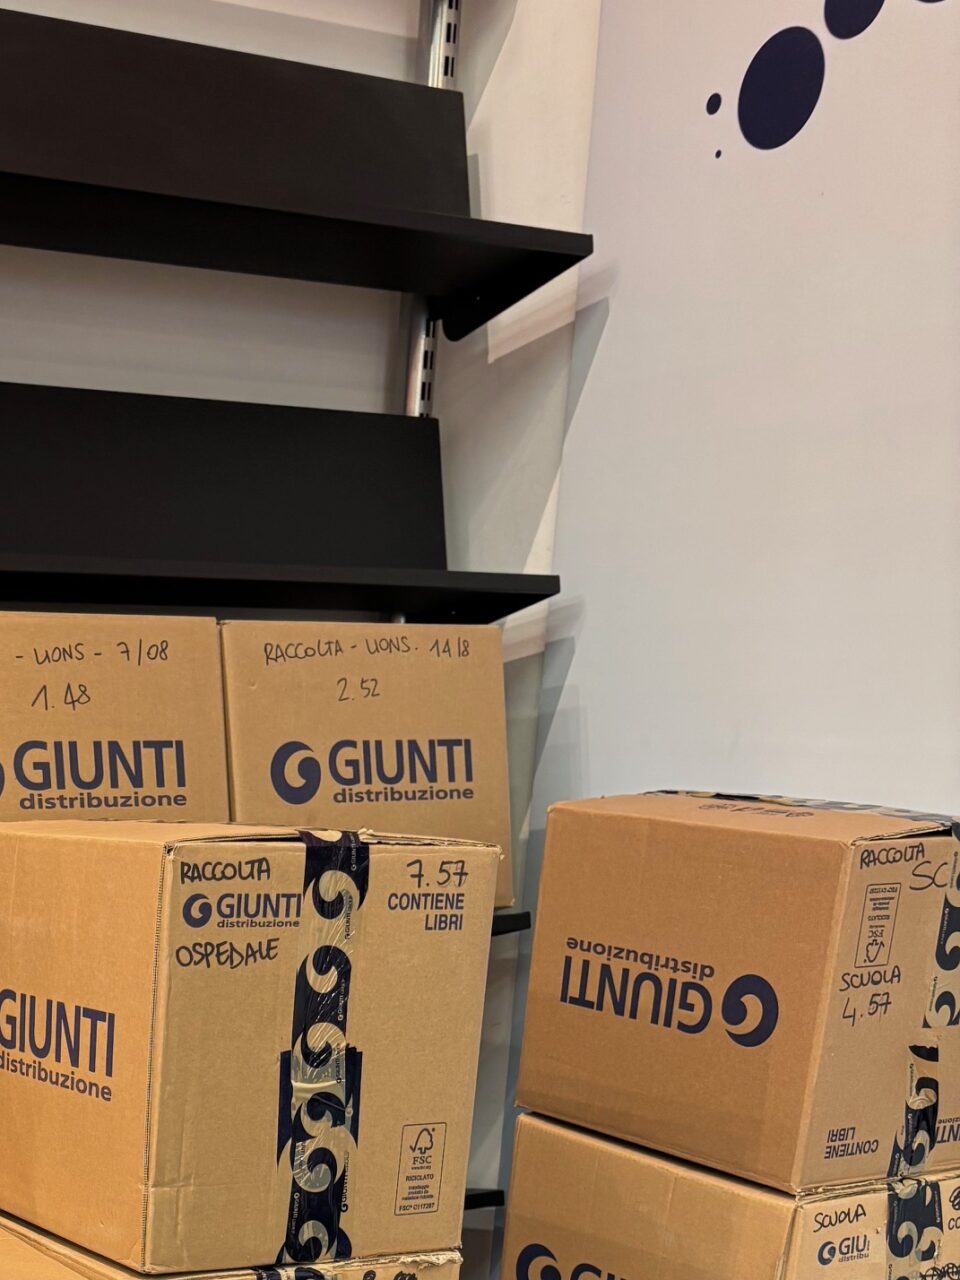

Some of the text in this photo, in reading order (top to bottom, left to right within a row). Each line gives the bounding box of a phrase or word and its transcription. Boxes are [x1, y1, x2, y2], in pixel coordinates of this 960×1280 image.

[117, 638, 169, 666] 7/08
[264, 639, 344, 666] RACCOLTA
[13, 739, 187, 791] GIUNTI
[328, 738, 474, 787] GIUNTI
[20, 791, 187, 811] distribuzione
[333, 786, 474, 804] distribuzione
[859, 843, 925, 870] RACCOLTA
[180, 857, 271, 884] RACCOLTA
[407, 858, 469, 888] 7.57
[216, 892, 302, 918] GIUNTI
[388, 892, 465, 911] CONTIENE
[217, 918, 300, 929] distribuzione
[424, 914, 463, 931] LIBRI
[175, 938, 280, 969] OSPEDALE
[566, 937, 715, 980] distribuzione
[839, 965, 901, 992] SCUOLA
[560, 955, 712, 1036] GIUNTI
[828, 1127, 856, 1143] LIBRI
[824, 1139, 878, 1159] CONTIENE
[814, 1204, 867, 1233] SCUOLA
